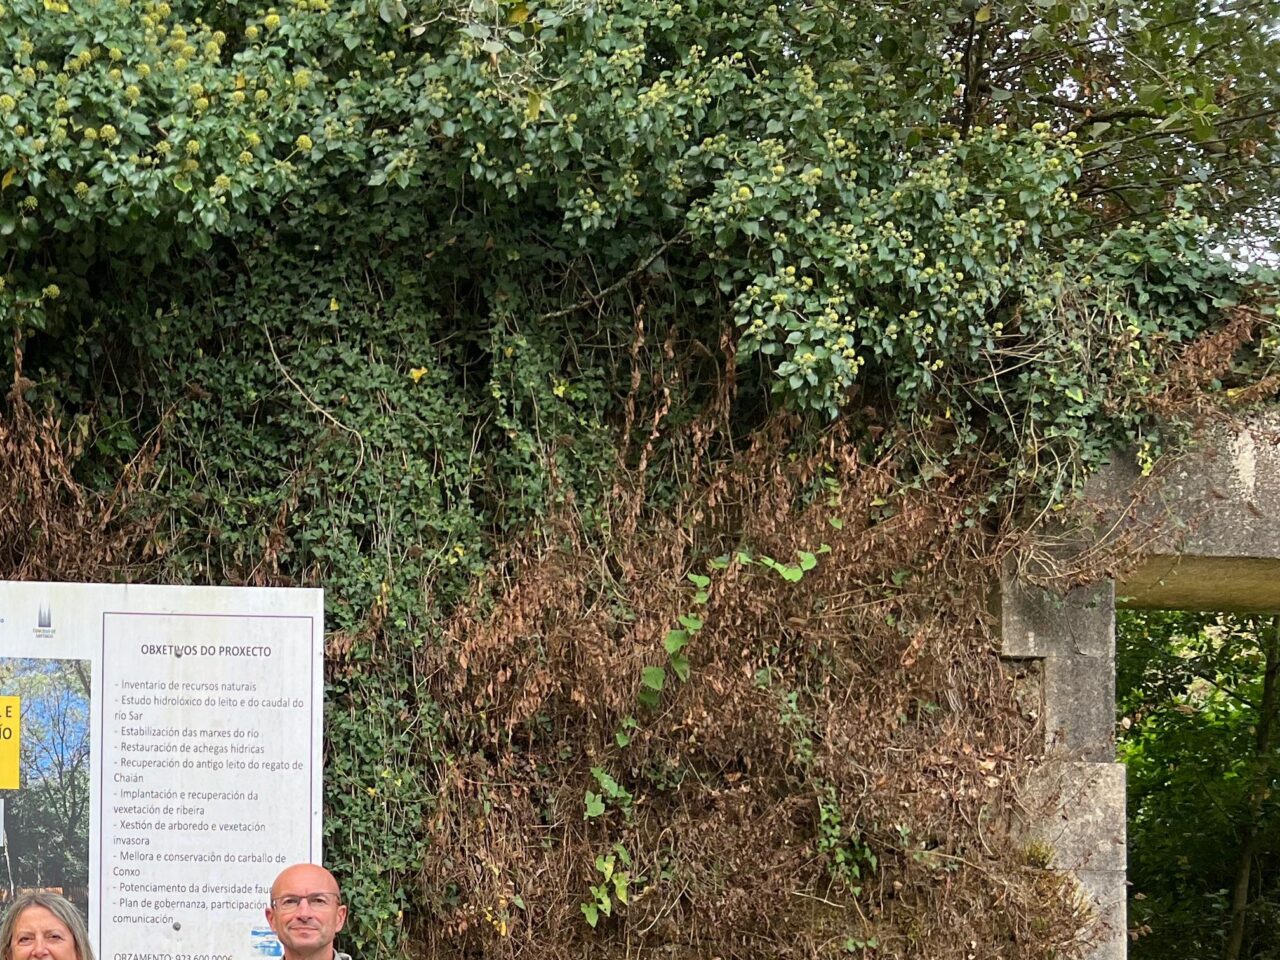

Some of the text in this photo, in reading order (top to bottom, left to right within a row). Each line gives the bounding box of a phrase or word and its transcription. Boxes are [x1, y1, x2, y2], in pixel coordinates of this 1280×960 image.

[141, 645, 271, 656] OBXETIVOS DO PROXECTO
[122, 680, 166, 690] Inventario
[169, 681, 179, 690] de
[182, 683, 218, 691] recursos
[222, 683, 256, 691] naturais
[122, 695, 151, 705] Estudo
[154, 696, 202, 706] hidrolóxico
[205, 697, 216, 706] do
[218, 697, 237, 707] leito
[240, 699, 245, 707] e
[248, 698, 259, 707] do
[261, 698, 290, 707] caudal
[293, 698, 304, 707] do
[6, 706, 12, 718] E
[115, 711, 143, 720] río Sar
[122, 726, 179, 736] Estabilización
[182, 728, 197, 737] das
[233, 728, 245, 738] do
[247, 729, 259, 738] río
[121, 742, 177, 752] Restauración
[180, 743, 191, 752] de
[193, 743, 228, 755] achegas
[231, 744, 264, 754] hídricas
[121, 758, 179, 769] Recuperación
[183, 759, 194, 768] do
[196, 760, 223, 771] antigo
[226, 760, 246, 769] leito
[248, 760, 259, 769] do
[262, 761, 289, 771] regato
[292, 760, 303, 770] de
[114, 773, 143, 782] Chaián
[121, 789, 177, 800] Implantación
[188, 791, 245, 801] recuperación
[248, 792, 258, 800] da
[114, 805, 204, 815] vexetación de ribeira
[120, 820, 152, 830] Xestión
[155, 821, 165, 830] de
[168, 821, 209, 830] arboredo
[219, 823, 265, 831] vexetación
[120, 851, 153, 861] Mellora
[164, 852, 221, 862] conservación
[224, 853, 235, 862] do
[238, 853, 273, 863] carballo
[275, 854, 286, 863] de
[113, 867, 140, 876] Conxo
[120, 883, 186, 892] Potenciamento
[189, 883, 199, 893] da
[202, 884, 252, 893] diversidade
[120, 898, 138, 907] Plan
[141, 898, 152, 908] de
[154, 898, 208, 910] gobernanza,
[211, 900, 267, 910] participación
[113, 915, 174, 924] comunicación
